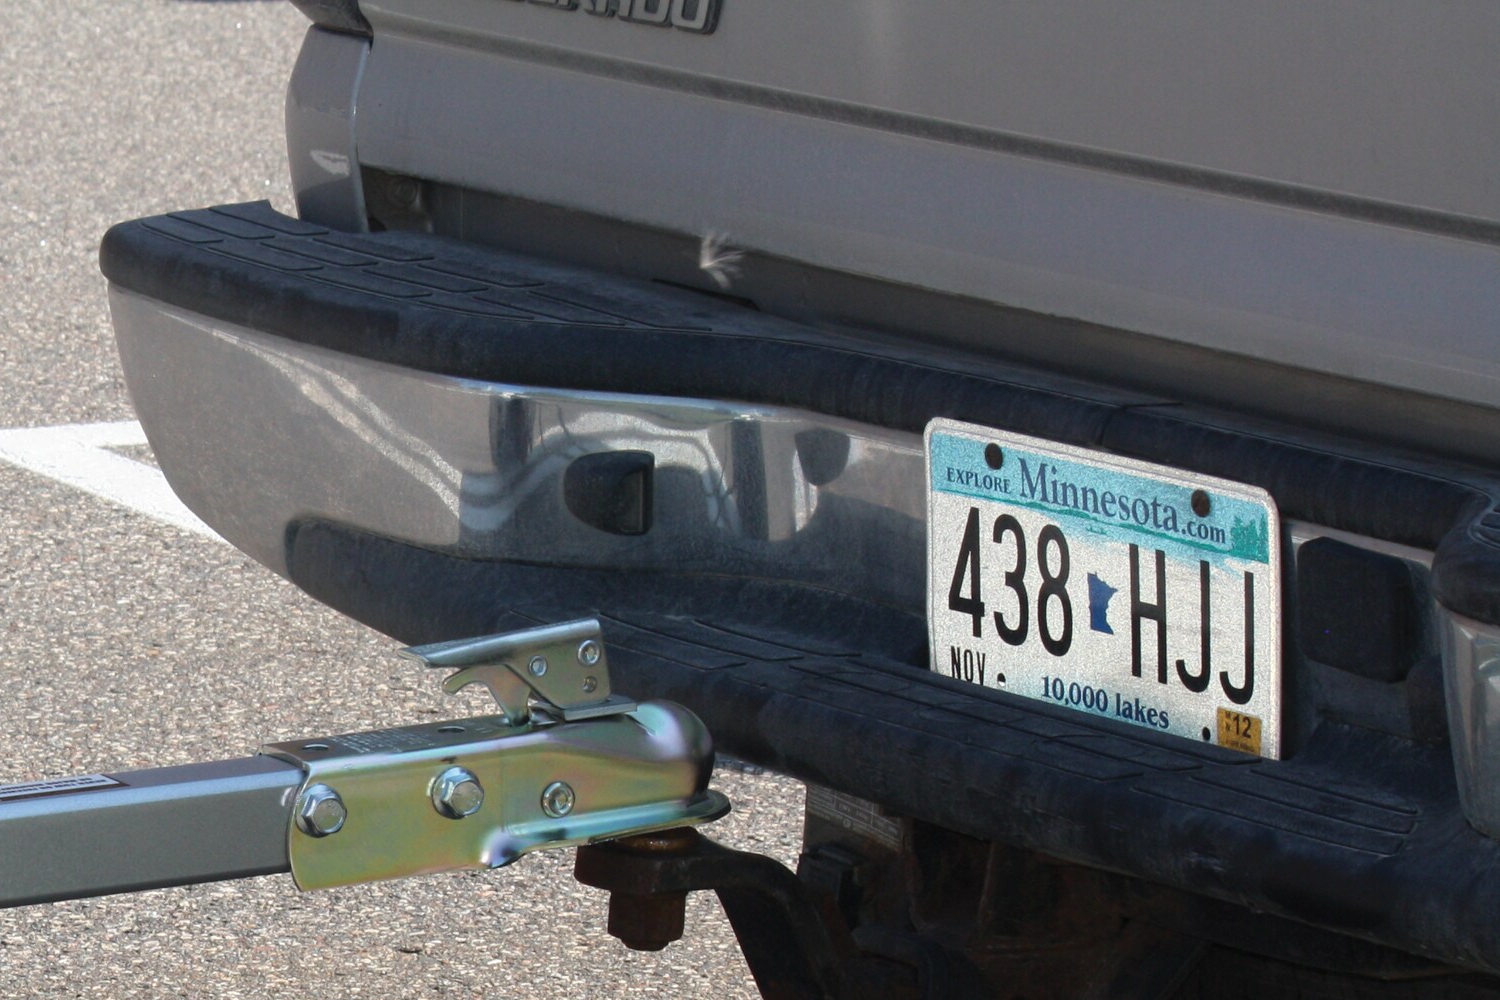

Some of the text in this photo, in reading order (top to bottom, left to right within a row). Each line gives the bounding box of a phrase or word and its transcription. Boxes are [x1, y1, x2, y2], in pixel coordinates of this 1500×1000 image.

[946, 456, 1227, 545] EXPLORE Minnesota.com
[948, 506, 1255, 705] 438 HJJ
[950, 645, 986, 686] NOV
[1040, 675, 1170, 730] 10,000 lakes
[1232, 713, 1252, 739] 12
